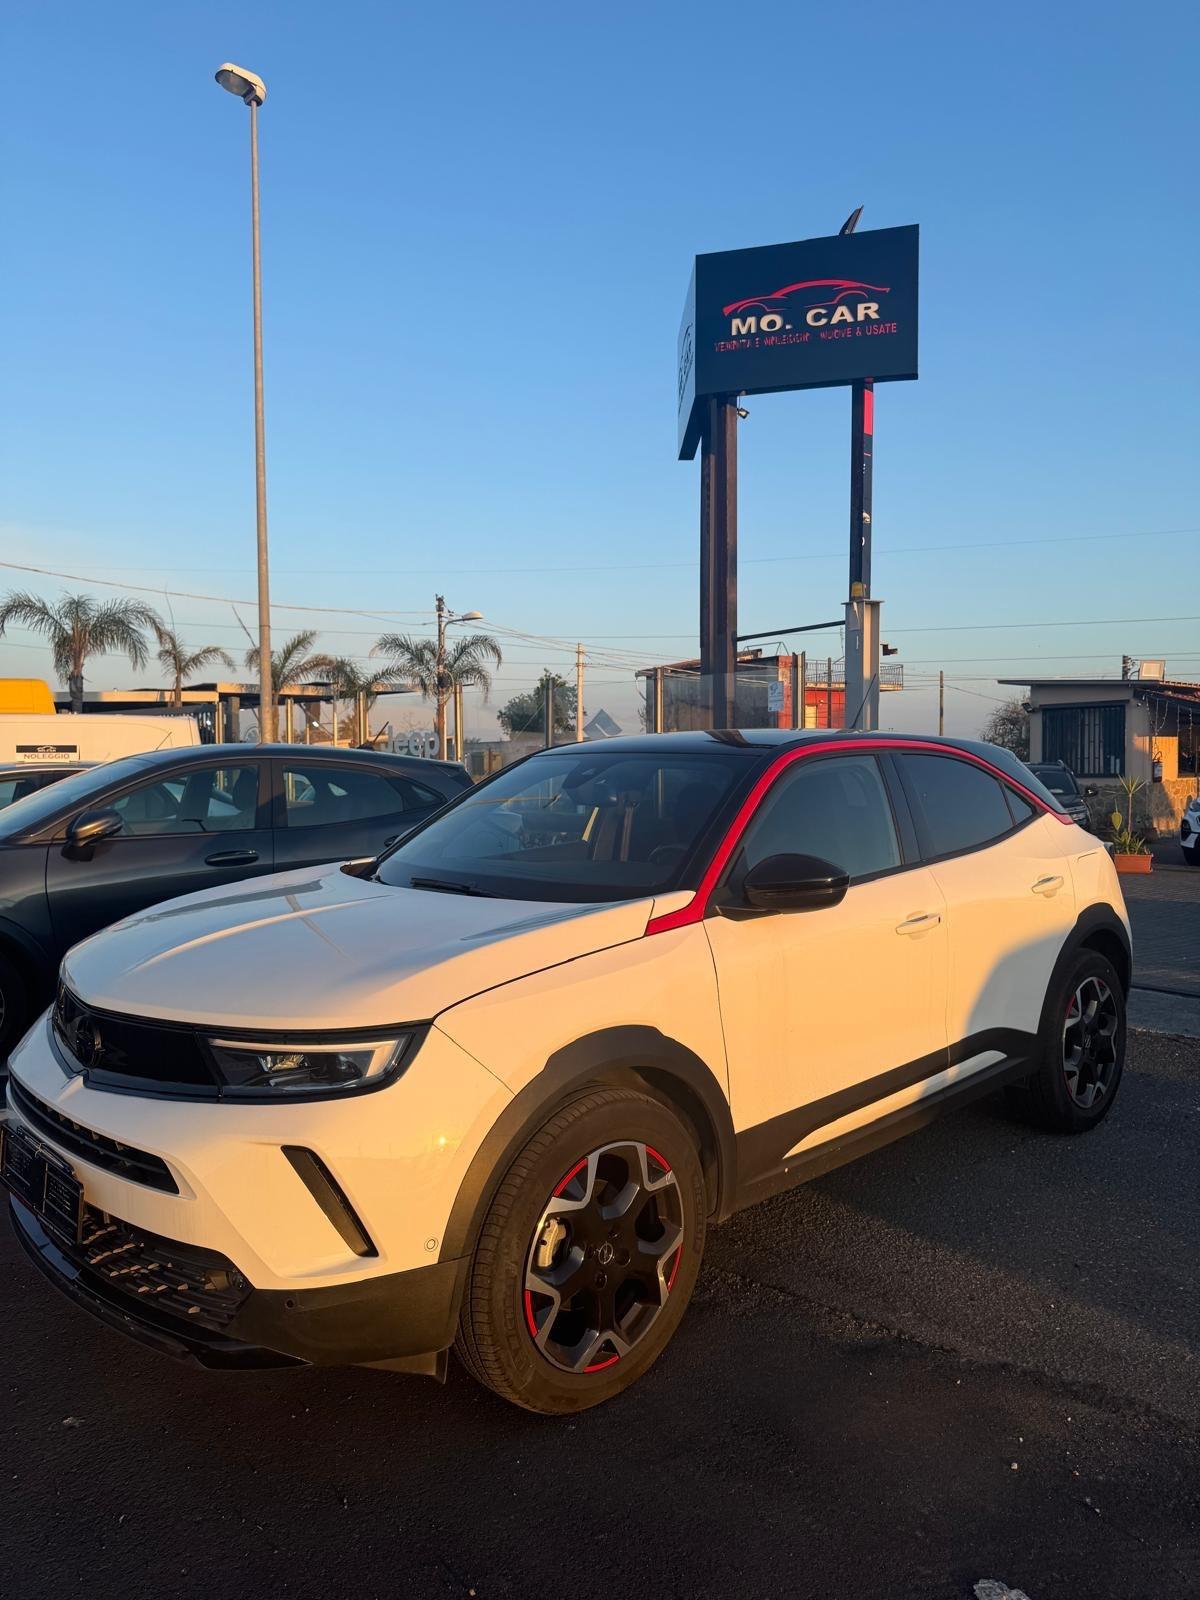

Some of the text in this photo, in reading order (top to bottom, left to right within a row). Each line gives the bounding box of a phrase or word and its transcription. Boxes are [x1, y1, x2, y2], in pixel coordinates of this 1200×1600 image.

[731, 302, 880, 336] MO. CAR
[820, 327, 852, 340] NUOVE
[856, 326, 862, 337] &
[865, 322, 897, 336] USATE
[381, 725, 440, 758] Jeep
